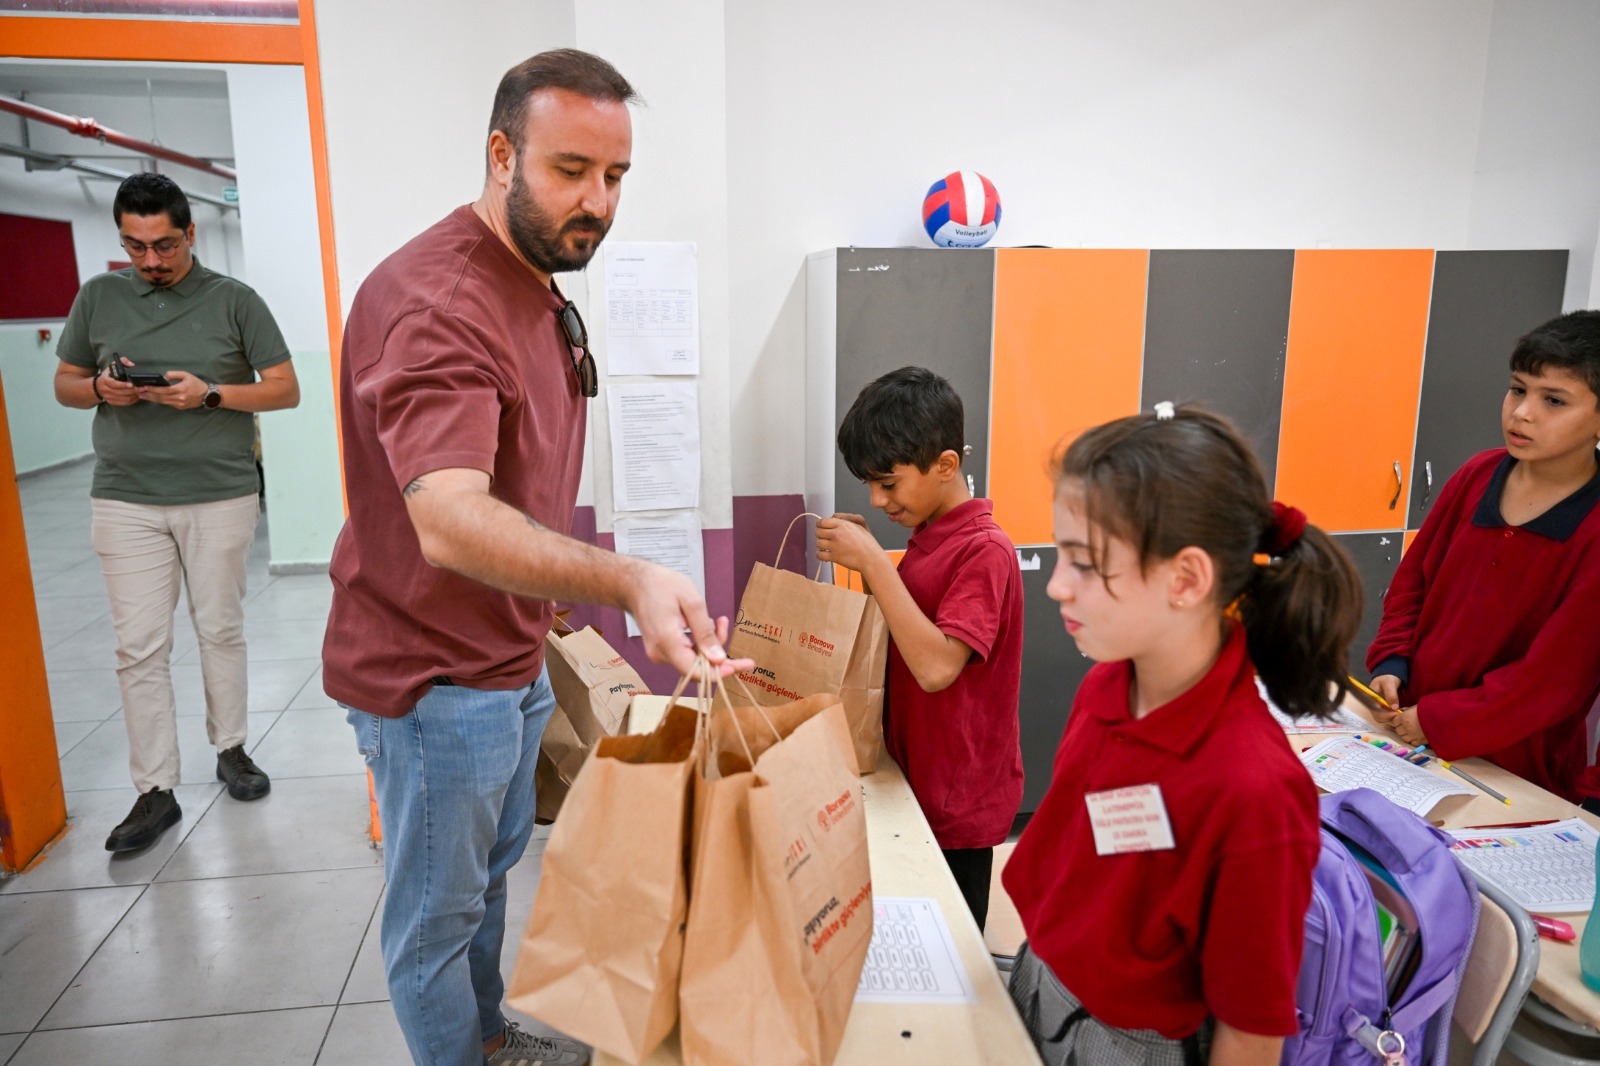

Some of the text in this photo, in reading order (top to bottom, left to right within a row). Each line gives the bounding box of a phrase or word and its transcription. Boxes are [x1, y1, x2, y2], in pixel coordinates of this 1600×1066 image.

[956, 229, 988, 238] Volleyball
[807, 643, 833, 658] Belediyesi
[809, 635, 835, 651] Bornova
[738, 671, 767, 688] birlikte
